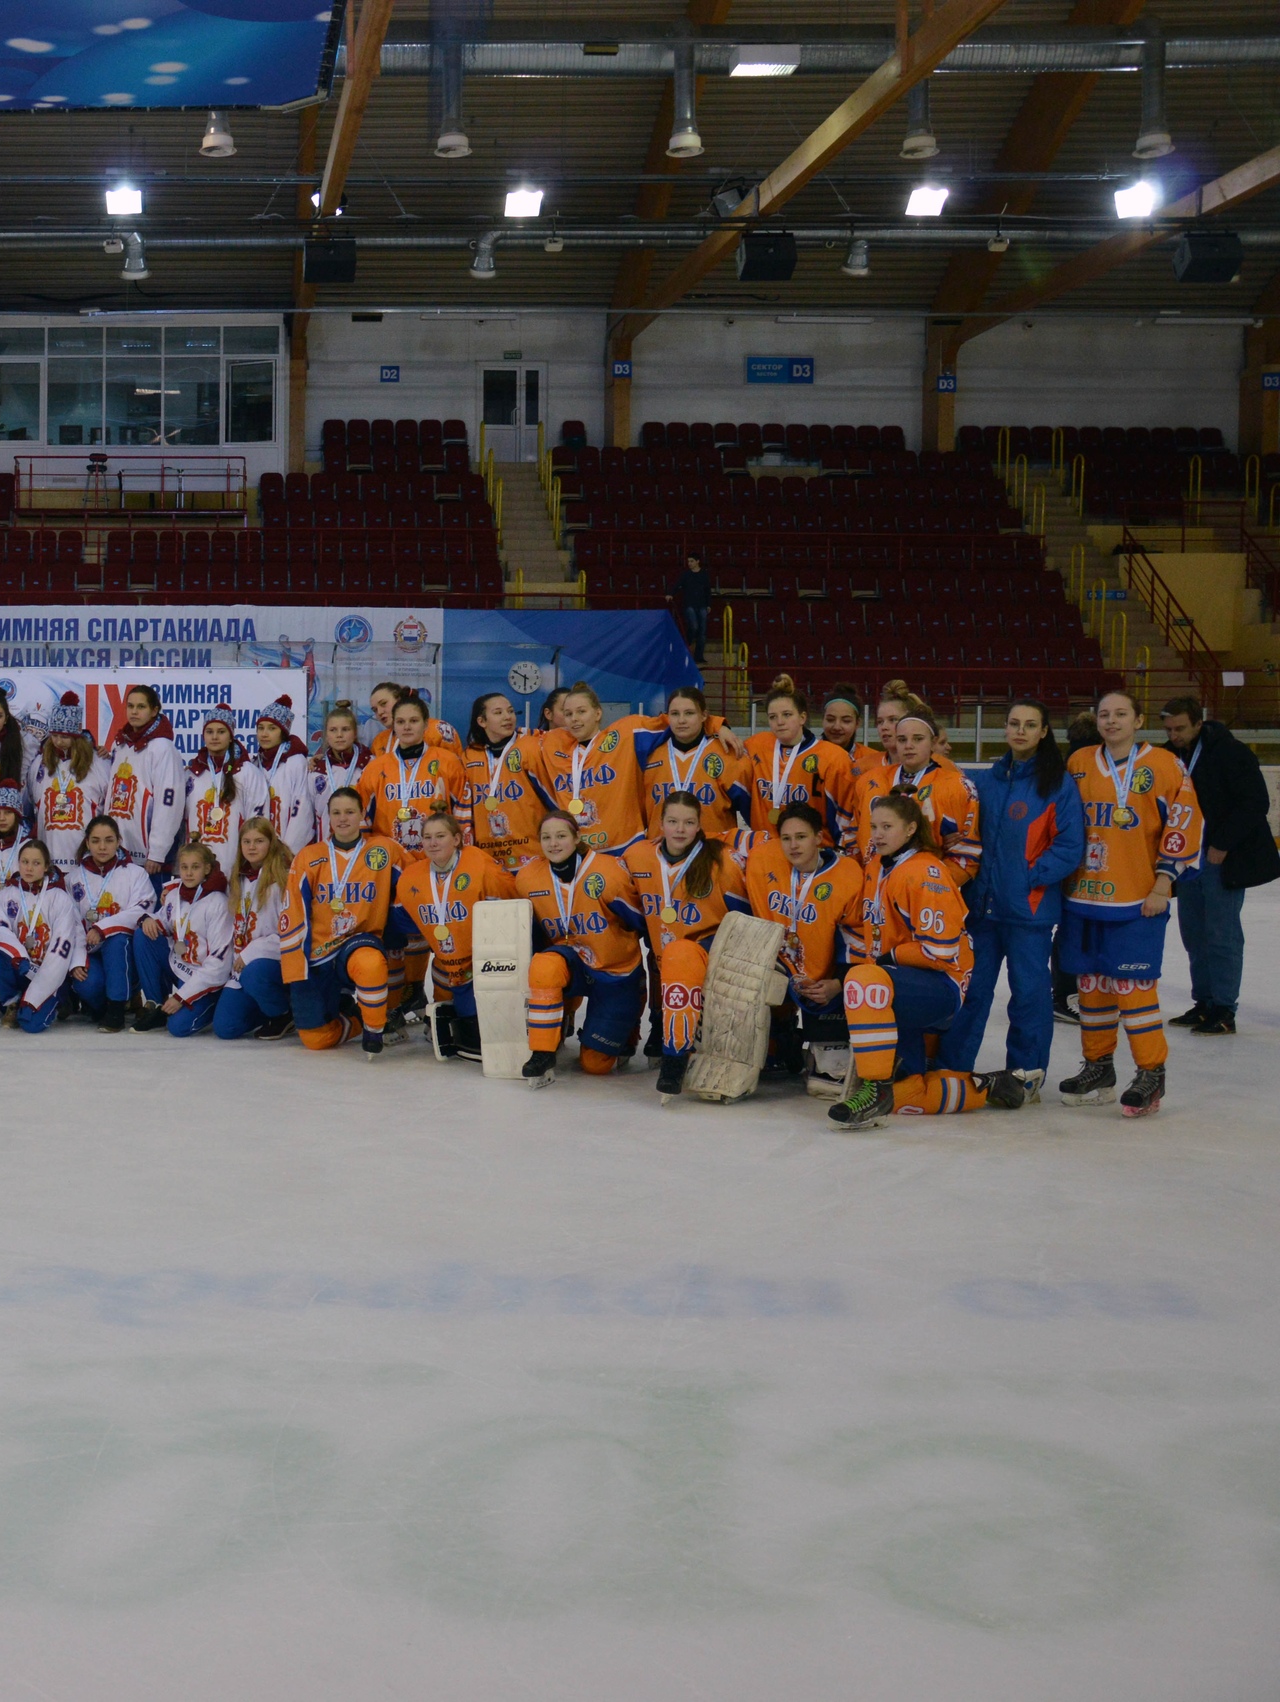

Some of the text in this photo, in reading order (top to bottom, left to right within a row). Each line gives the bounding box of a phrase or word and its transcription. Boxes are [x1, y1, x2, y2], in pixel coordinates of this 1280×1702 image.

[382, 369, 397, 379] D2
[614, 364, 629, 374] D3
[792, 365, 811, 377] D3
[938, 379, 954, 390] D3
[1263, 376, 1280, 387] D3
[87, 618, 257, 643] СПАРТАКИАДА
[120, 648, 212, 667] РОССИИ
[163, 788, 174, 806] 8
[1167, 802, 1193, 830] 37
[1078, 879, 1115, 896] РЕСО
[541, 912, 608, 939] СКИФ
[919, 907, 945, 934] 96
[51, 937, 71, 959] 19
[177, 963, 193, 976] ОБЛА
